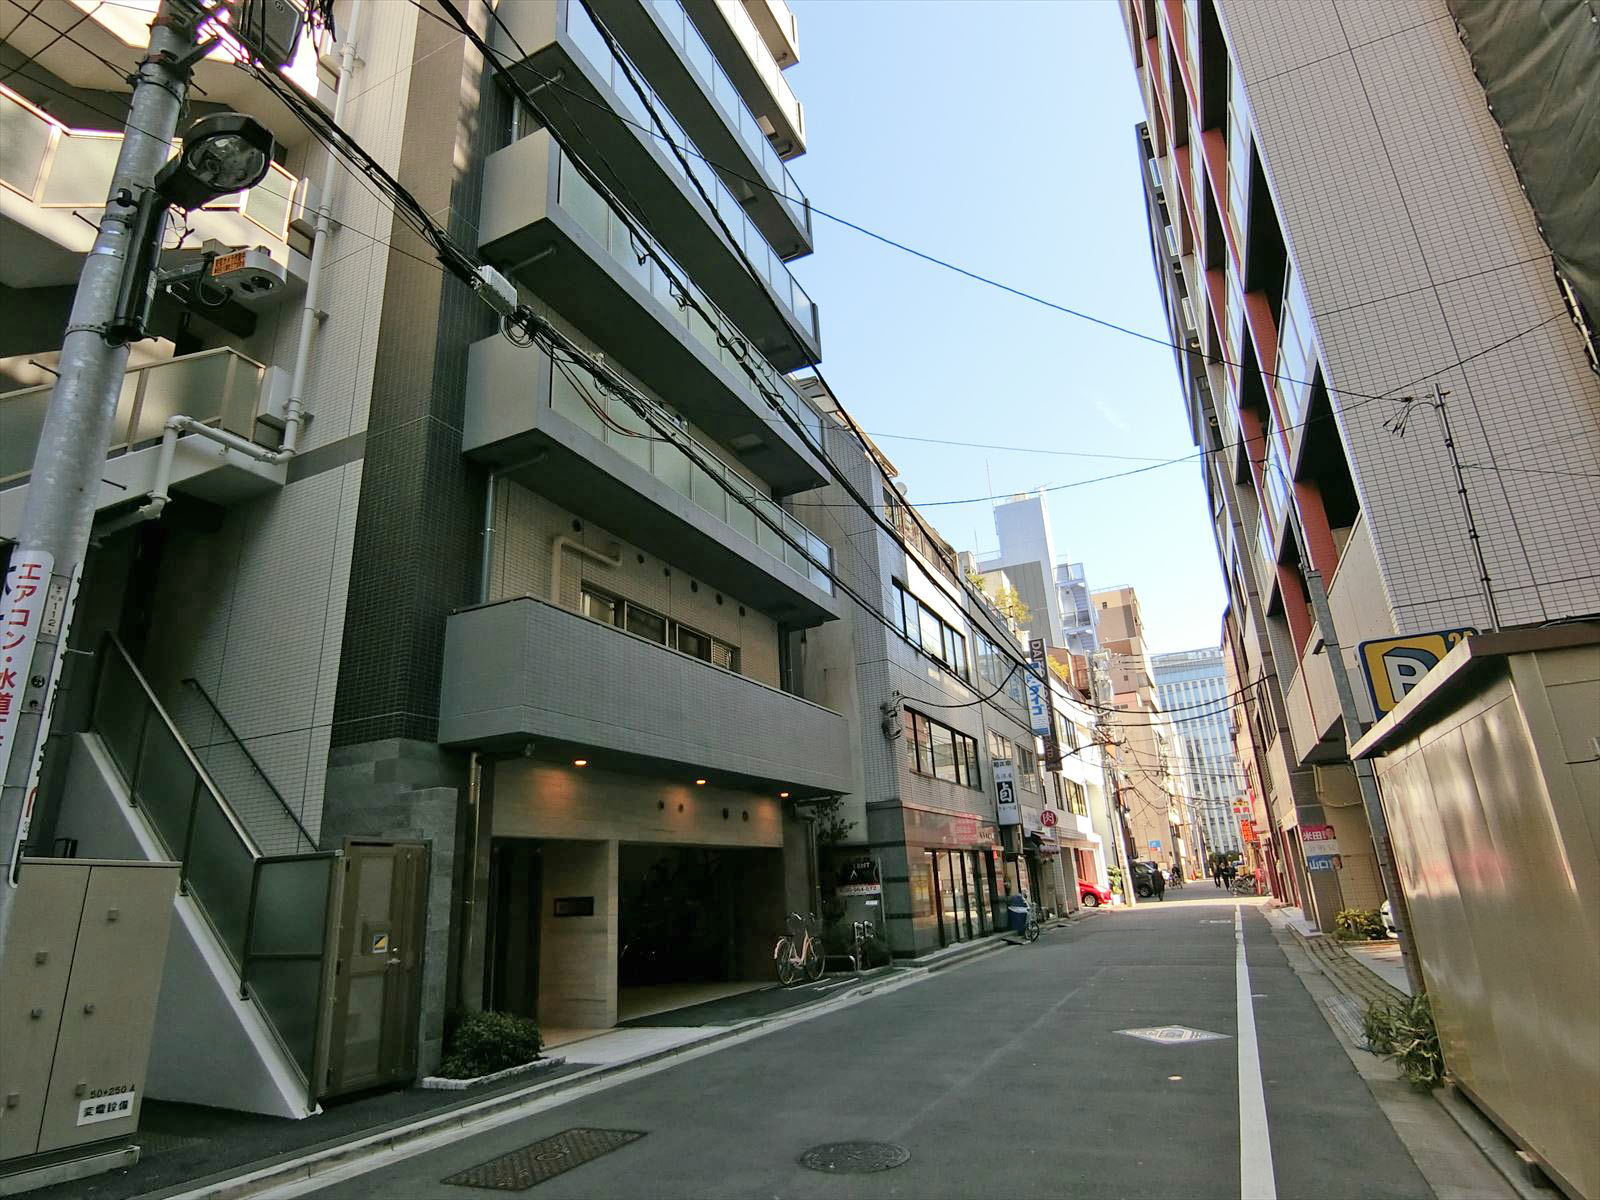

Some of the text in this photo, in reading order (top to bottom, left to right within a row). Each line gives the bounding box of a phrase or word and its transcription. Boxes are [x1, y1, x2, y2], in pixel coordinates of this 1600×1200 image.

[0, 563, 42, 741] エアコン・水道
[1042, 811, 1056, 826] 肉
[83, 1100, 129, 1117] 変電設備
